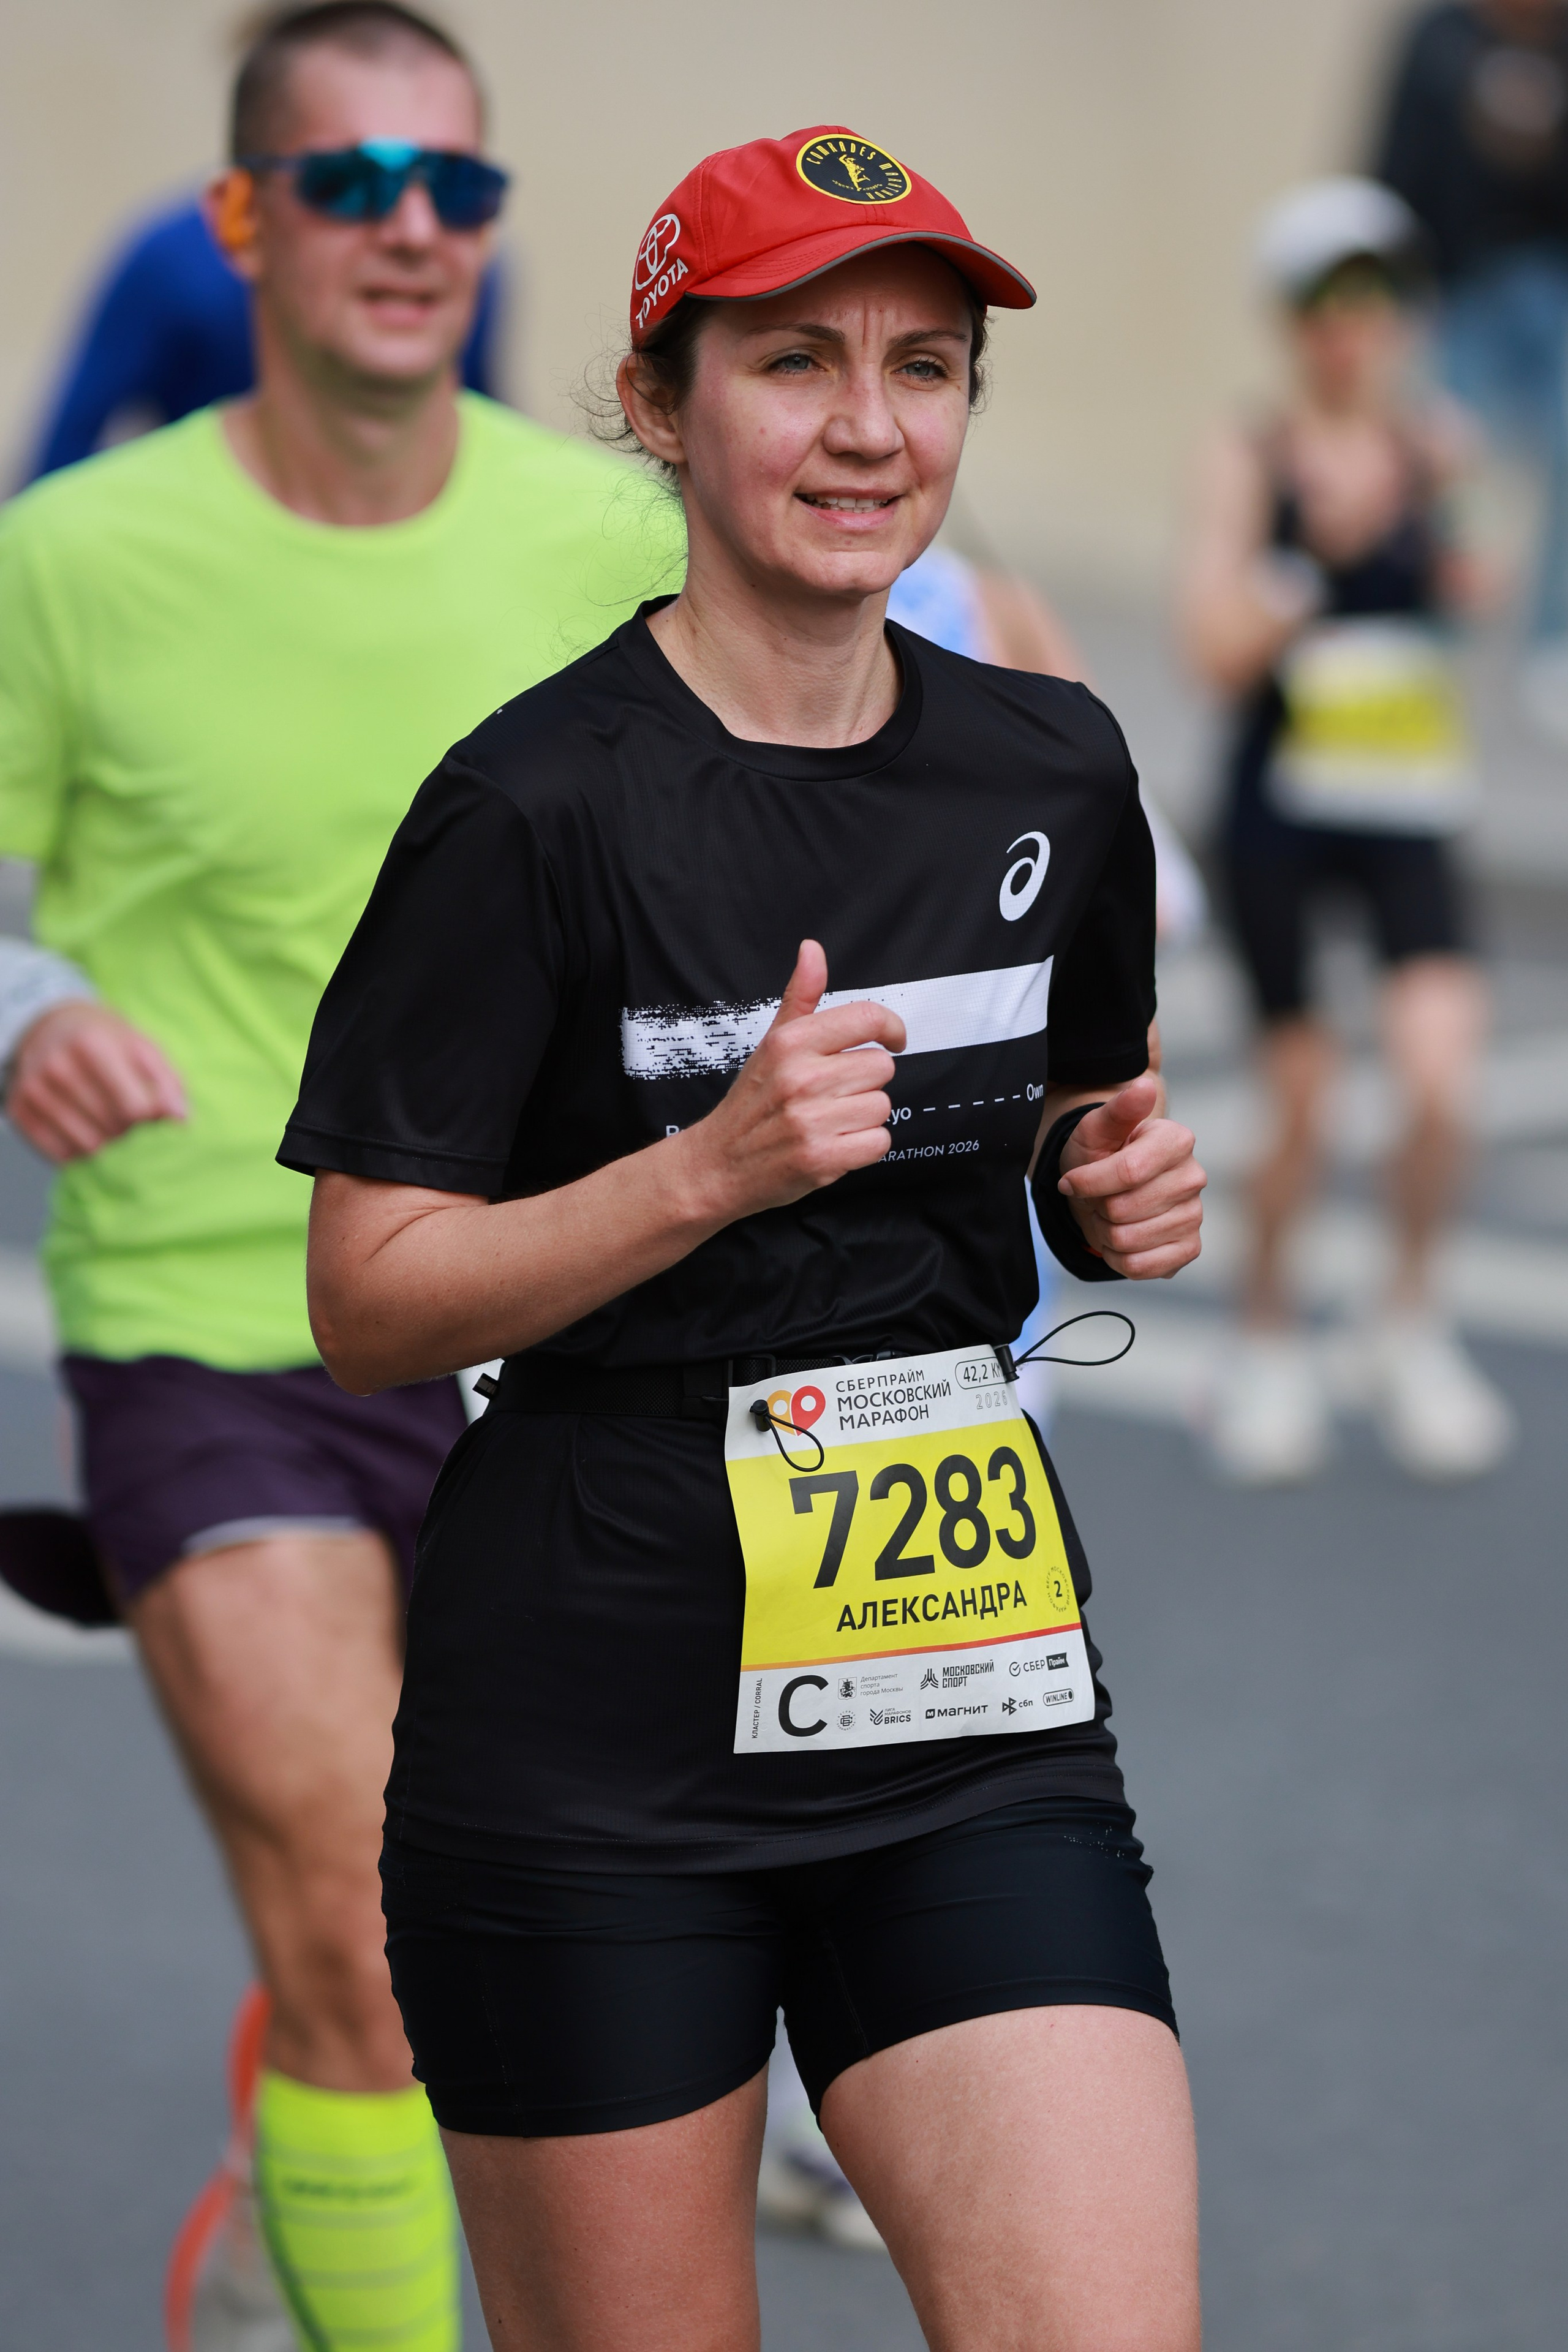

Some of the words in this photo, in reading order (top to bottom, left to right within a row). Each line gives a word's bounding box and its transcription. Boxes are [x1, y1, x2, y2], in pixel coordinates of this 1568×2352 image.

[805, 141, 876, 165] COMRADES
[865, 162, 902, 200] MARATHON
[635, 257, 689, 329] TOYOTA
[877, 1144, 945, 1163] ARATHON
[948, 1139, 980, 1155] 2026
[835, 1369, 925, 1393] СБЕРПРАЙМ
[963, 1364, 989, 1383] 42,2
[837, 1379, 952, 1412] МОСКОВСКИЙ
[976, 1390, 1008, 1410] 2026
[839, 1404, 929, 1431] МАРАФОН
[788, 1446, 1036, 1589] 7283
[1054, 1580, 1063, 1597] 2
[835, 1580, 1028, 1632] АЛЕКСАНДРА
[942, 1659, 995, 1678] МОСКОВСКИЙ
[1023, 1659, 1046, 1672] СБЕР
[1048, 1656, 1066, 1668] Прайм
[860, 1673, 898, 1683] Департамент
[942, 1676, 968, 1689] СПОРТ
[1018, 1699, 1034, 1708] сбп
[1046, 1692, 1068, 1703] WINLINE
[884, 1714, 911, 1725] BRICS
[937, 1705, 989, 1717] магнит
[752, 1709, 760, 1739] КЛАСТЕР
